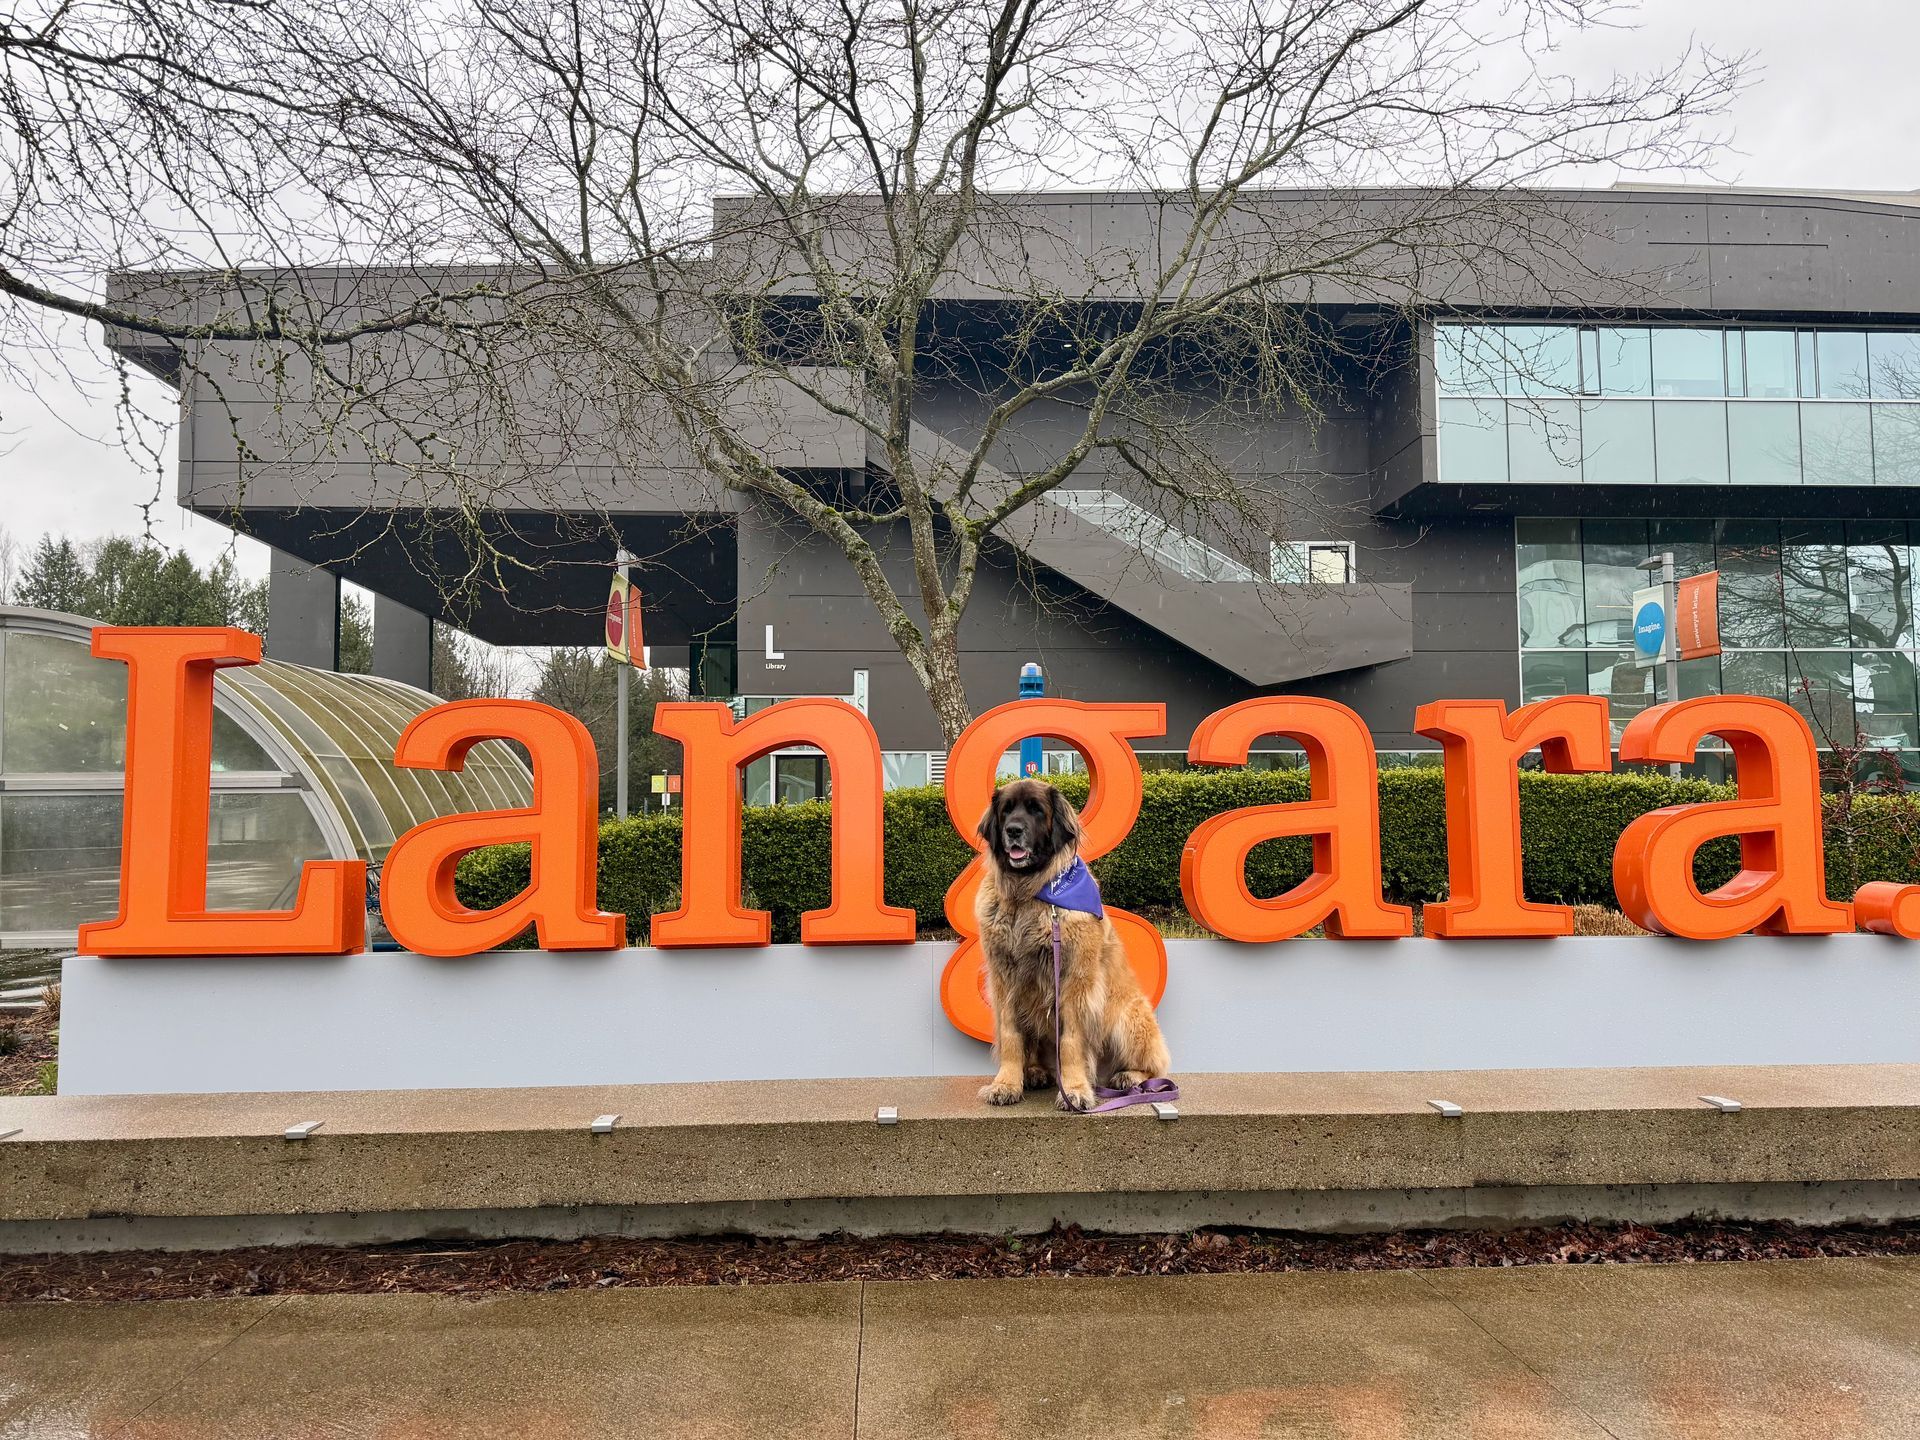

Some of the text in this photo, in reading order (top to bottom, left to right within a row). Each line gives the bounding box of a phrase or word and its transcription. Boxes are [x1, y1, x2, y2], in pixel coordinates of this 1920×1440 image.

[1638, 622, 1661, 634] Imagine.
[766, 625, 784, 659] L
[1027, 763, 1036, 772] 10
[1068, 869, 1078, 883] LOVE
